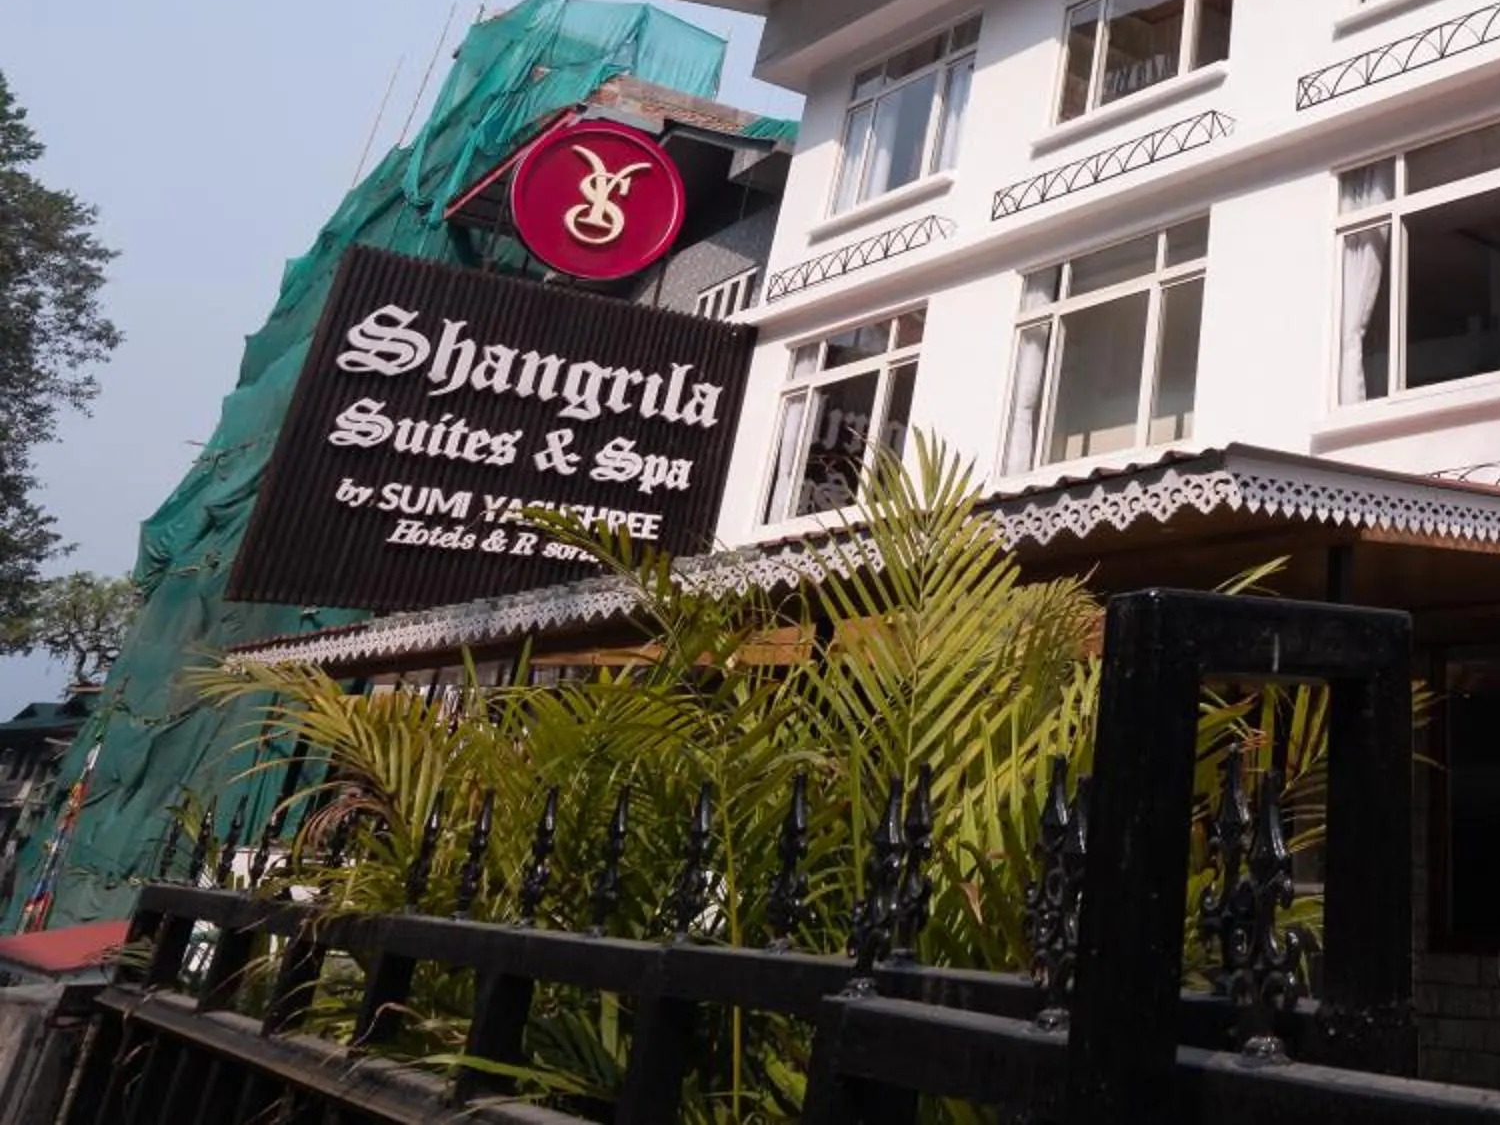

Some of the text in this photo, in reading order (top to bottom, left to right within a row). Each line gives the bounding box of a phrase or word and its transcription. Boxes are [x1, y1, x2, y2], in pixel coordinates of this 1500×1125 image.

[336, 304, 722, 429] Shangrila
[328, 397, 693, 495] Suites & Spa
[335, 477, 374, 507] by
[377, 482, 473, 519] SUMI
[386, 518, 477, 551] Hotels
[481, 527, 508, 554] &
